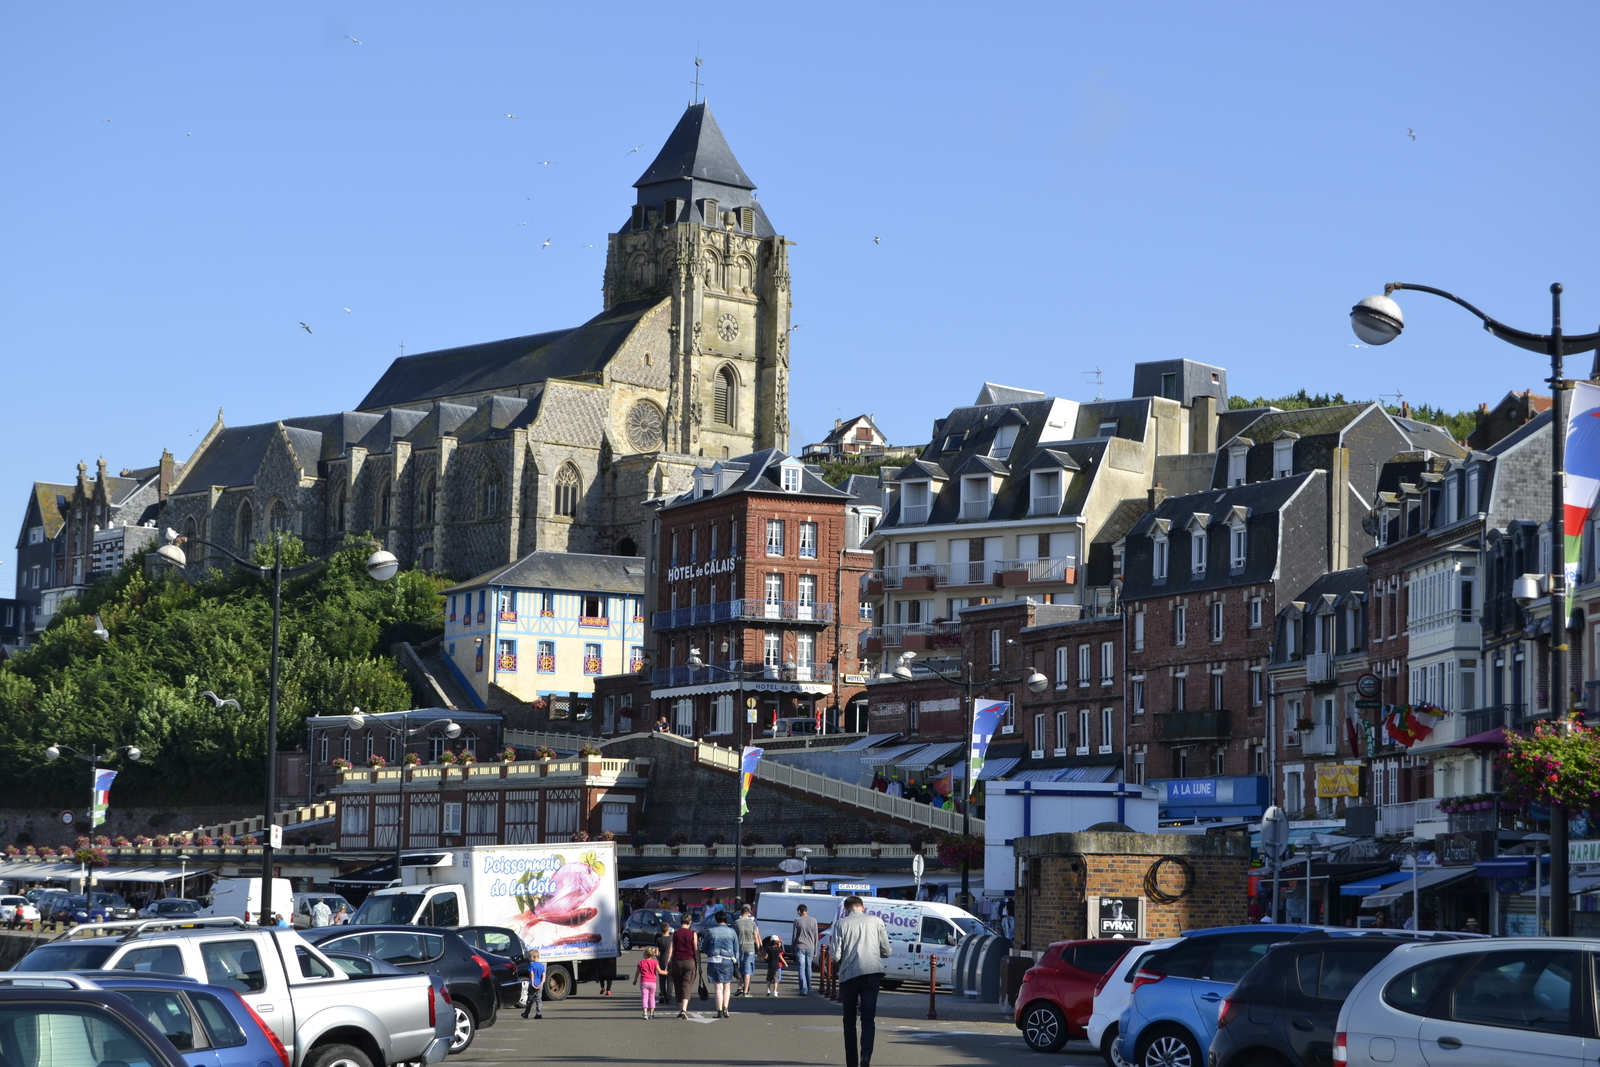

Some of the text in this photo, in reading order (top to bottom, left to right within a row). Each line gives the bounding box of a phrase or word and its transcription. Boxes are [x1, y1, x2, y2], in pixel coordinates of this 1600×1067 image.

[696, 567, 703, 577] de
[704, 557, 736, 576] CALAIS
[1172, 783, 1211, 795] A LA LUNE
[1570, 844, 1600, 860] HARM
[484, 854, 562, 875] Poissonnerie
[490, 879, 506, 896] de
[863, 908, 919, 928] atelote
